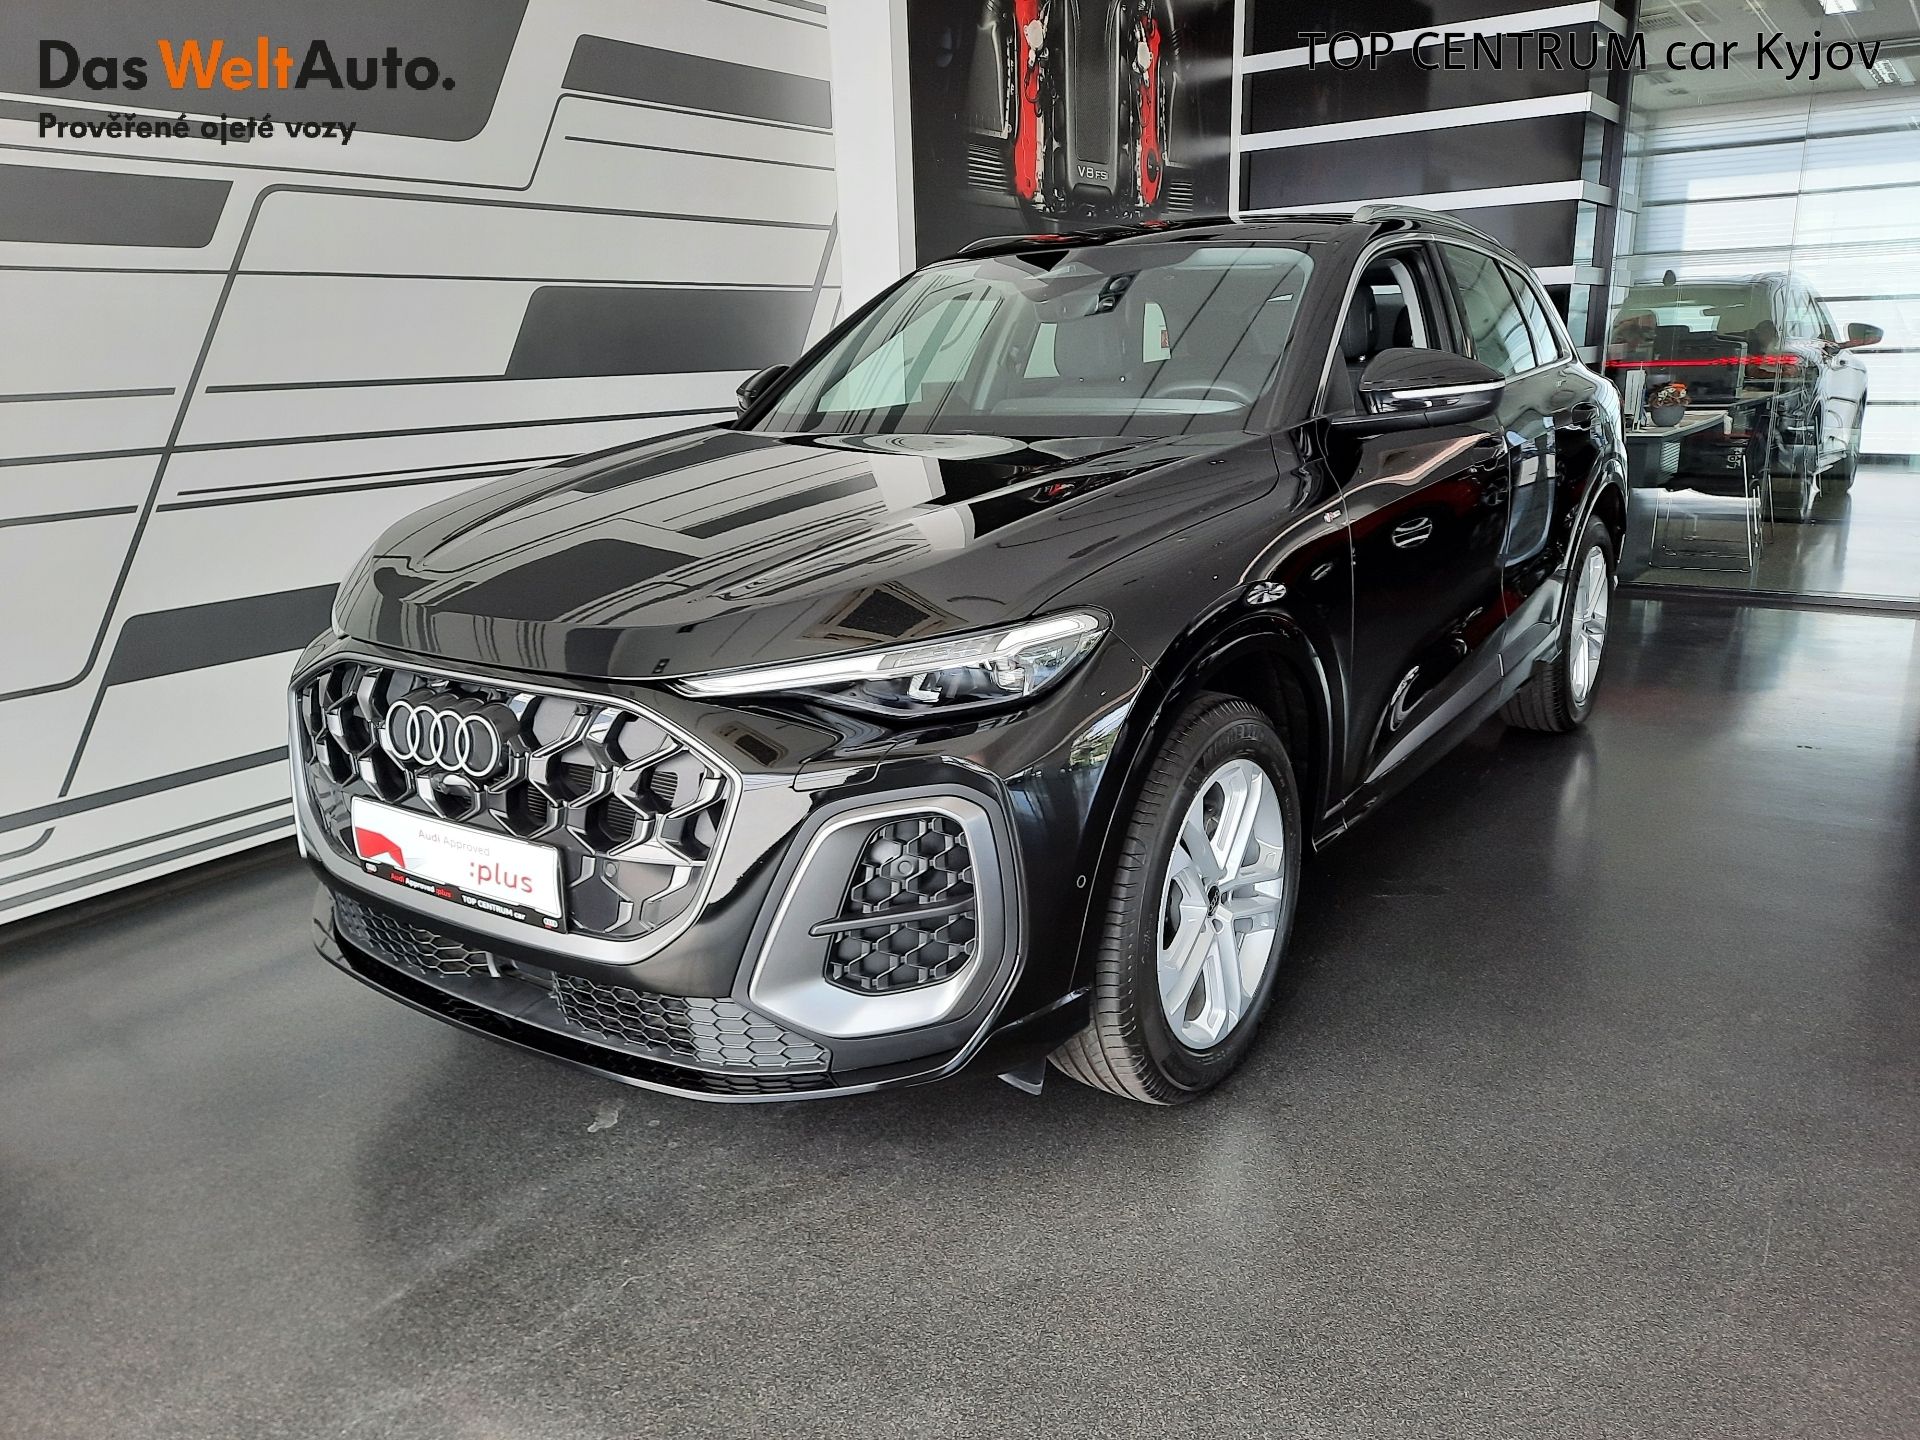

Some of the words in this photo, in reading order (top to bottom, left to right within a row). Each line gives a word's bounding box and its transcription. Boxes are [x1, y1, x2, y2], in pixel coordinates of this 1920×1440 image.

[418, 829, 441, 843] Audi
[443, 836, 490, 857] Approved
[391, 873, 404, 882] Audi
[405, 877, 435, 892] Approved
[461, 894, 477, 906] TOP
[477, 899, 513, 916] CENTRUM
[513, 912, 526, 921] car
